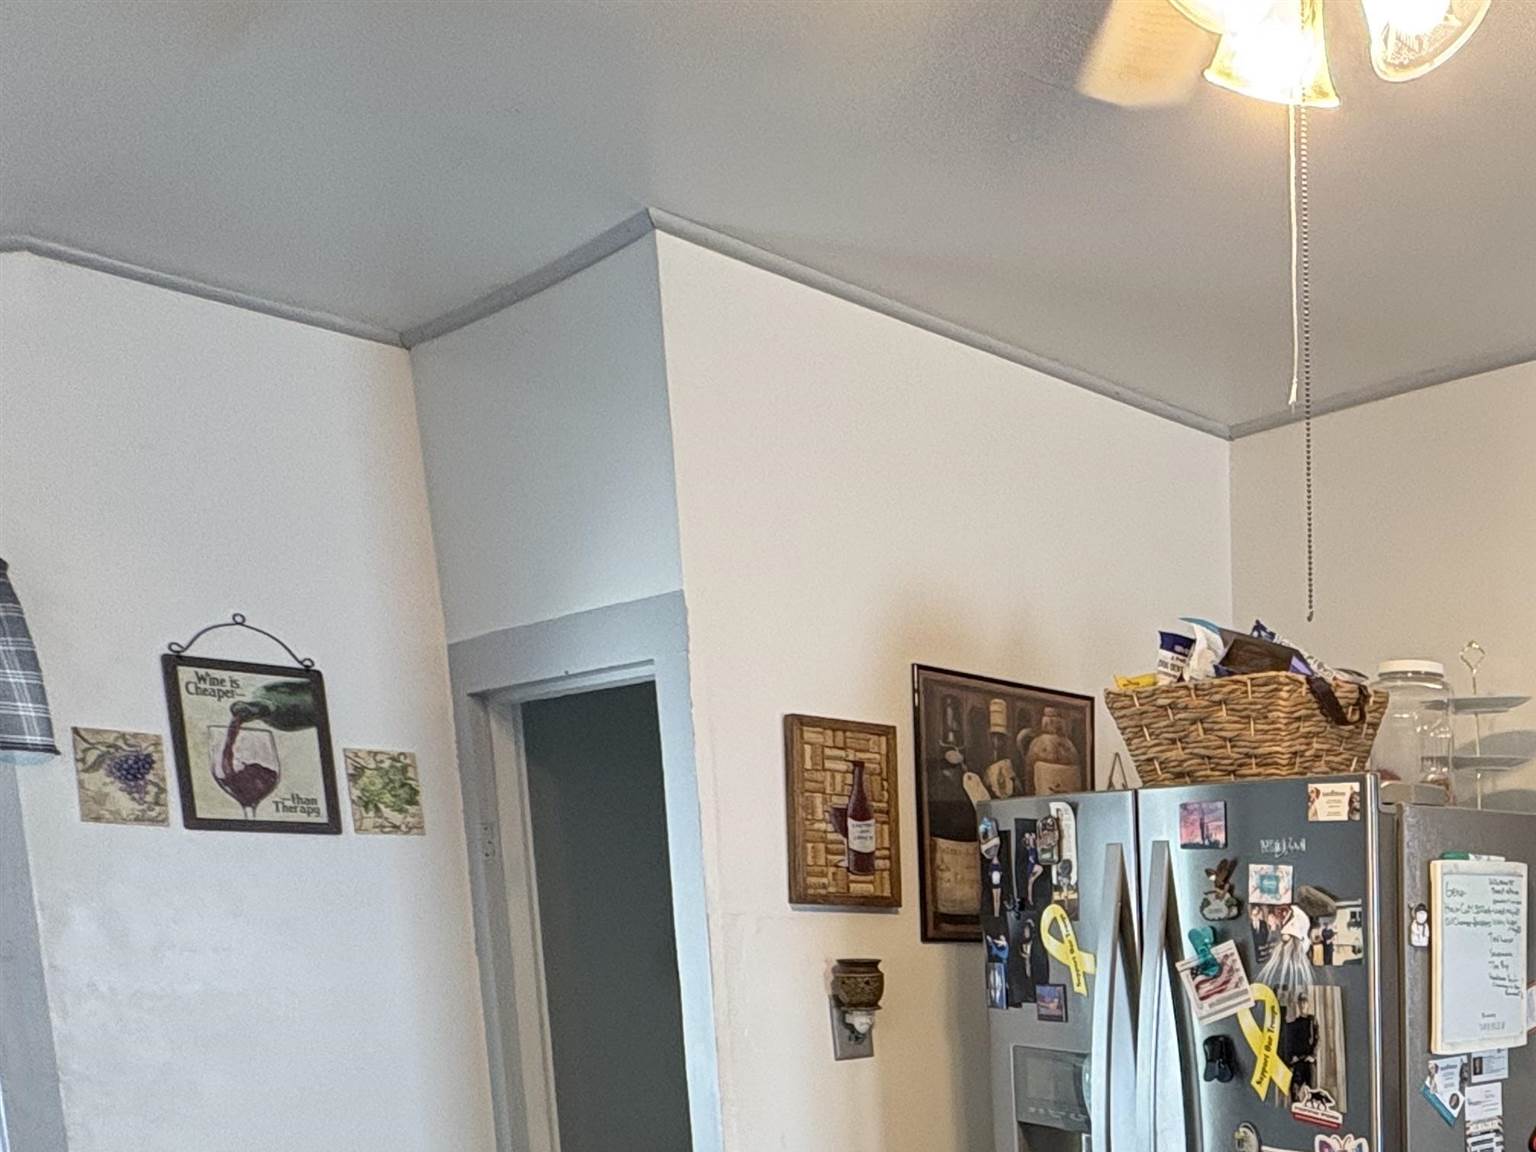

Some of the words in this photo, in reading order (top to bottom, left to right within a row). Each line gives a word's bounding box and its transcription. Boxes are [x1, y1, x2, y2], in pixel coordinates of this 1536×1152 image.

[193, 670, 227, 687] Wine
[229, 675, 241, 689] is
[272, 800, 321, 817] Therapy
[1256, 1054, 1270, 1085] Support
[1264, 1036, 1272, 1052] Our
